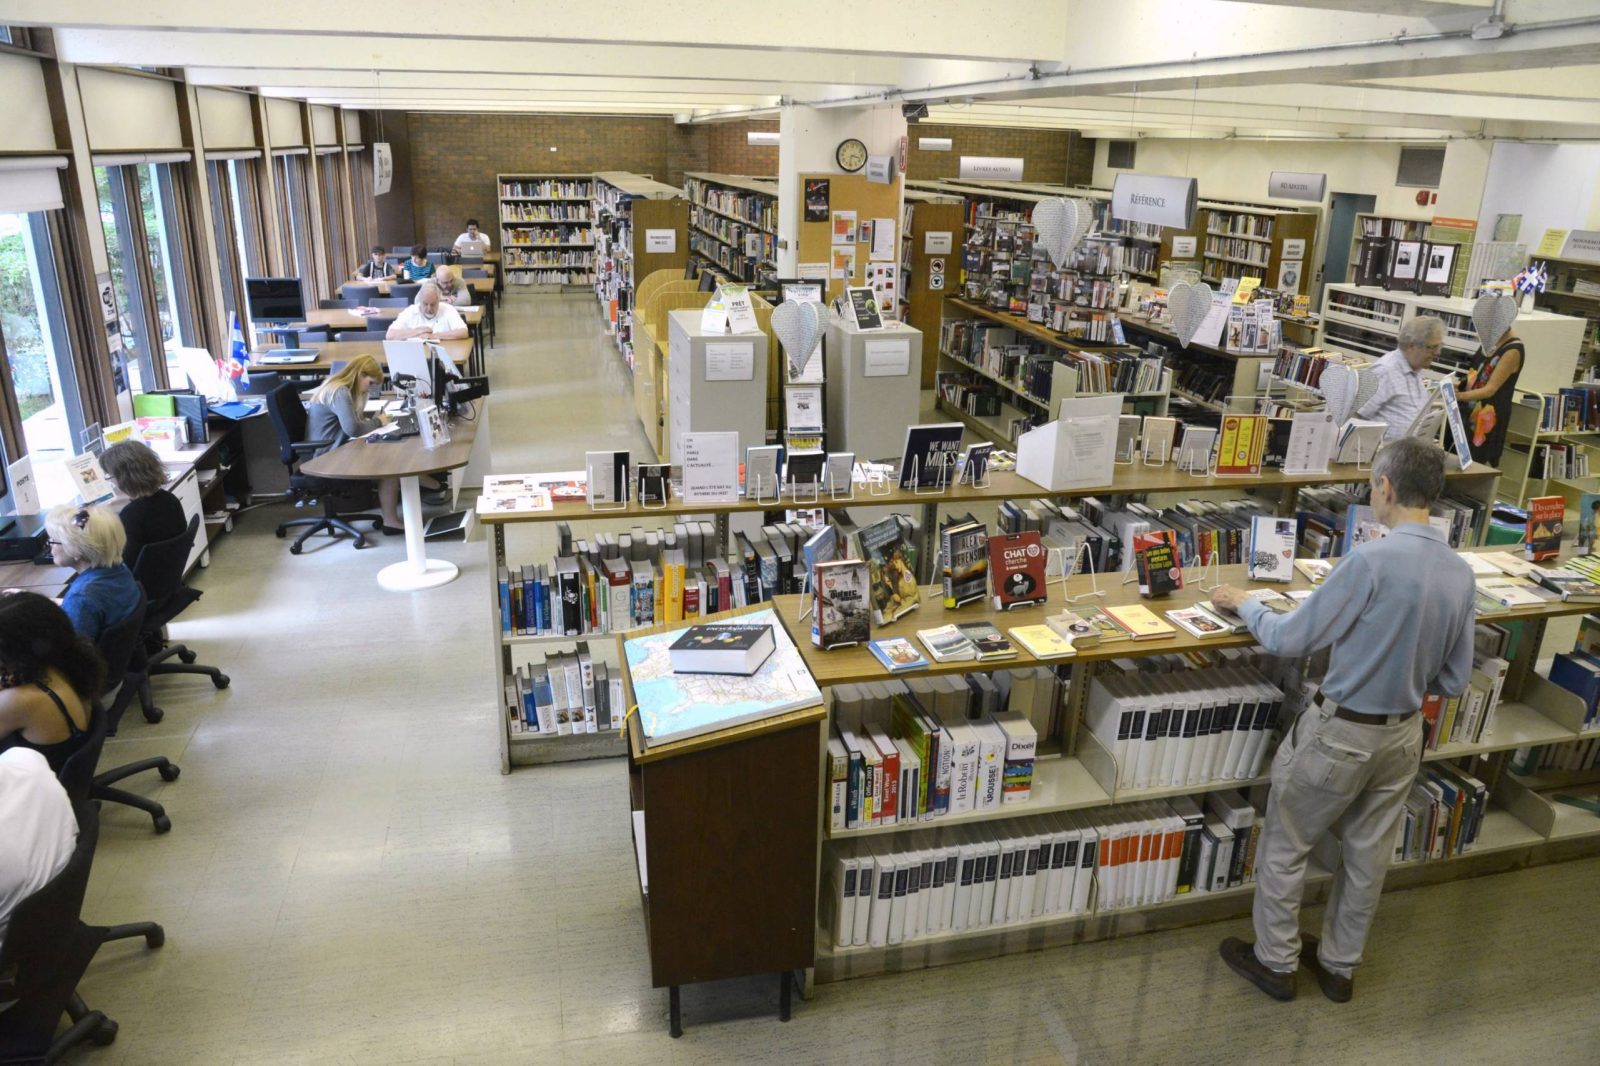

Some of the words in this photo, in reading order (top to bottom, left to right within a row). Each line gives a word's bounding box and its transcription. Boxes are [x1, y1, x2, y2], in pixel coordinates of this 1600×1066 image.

[1130, 192, 1166, 208] RÉFÉRENCE
[929, 441, 941, 451] WE
[941, 440, 960, 451] WANT
[925, 450, 958, 467] MILES
[961, 534, 977, 550] ALEX
[1003, 548, 1027, 559] CHAT
[1011, 742, 1035, 750] Dixel
